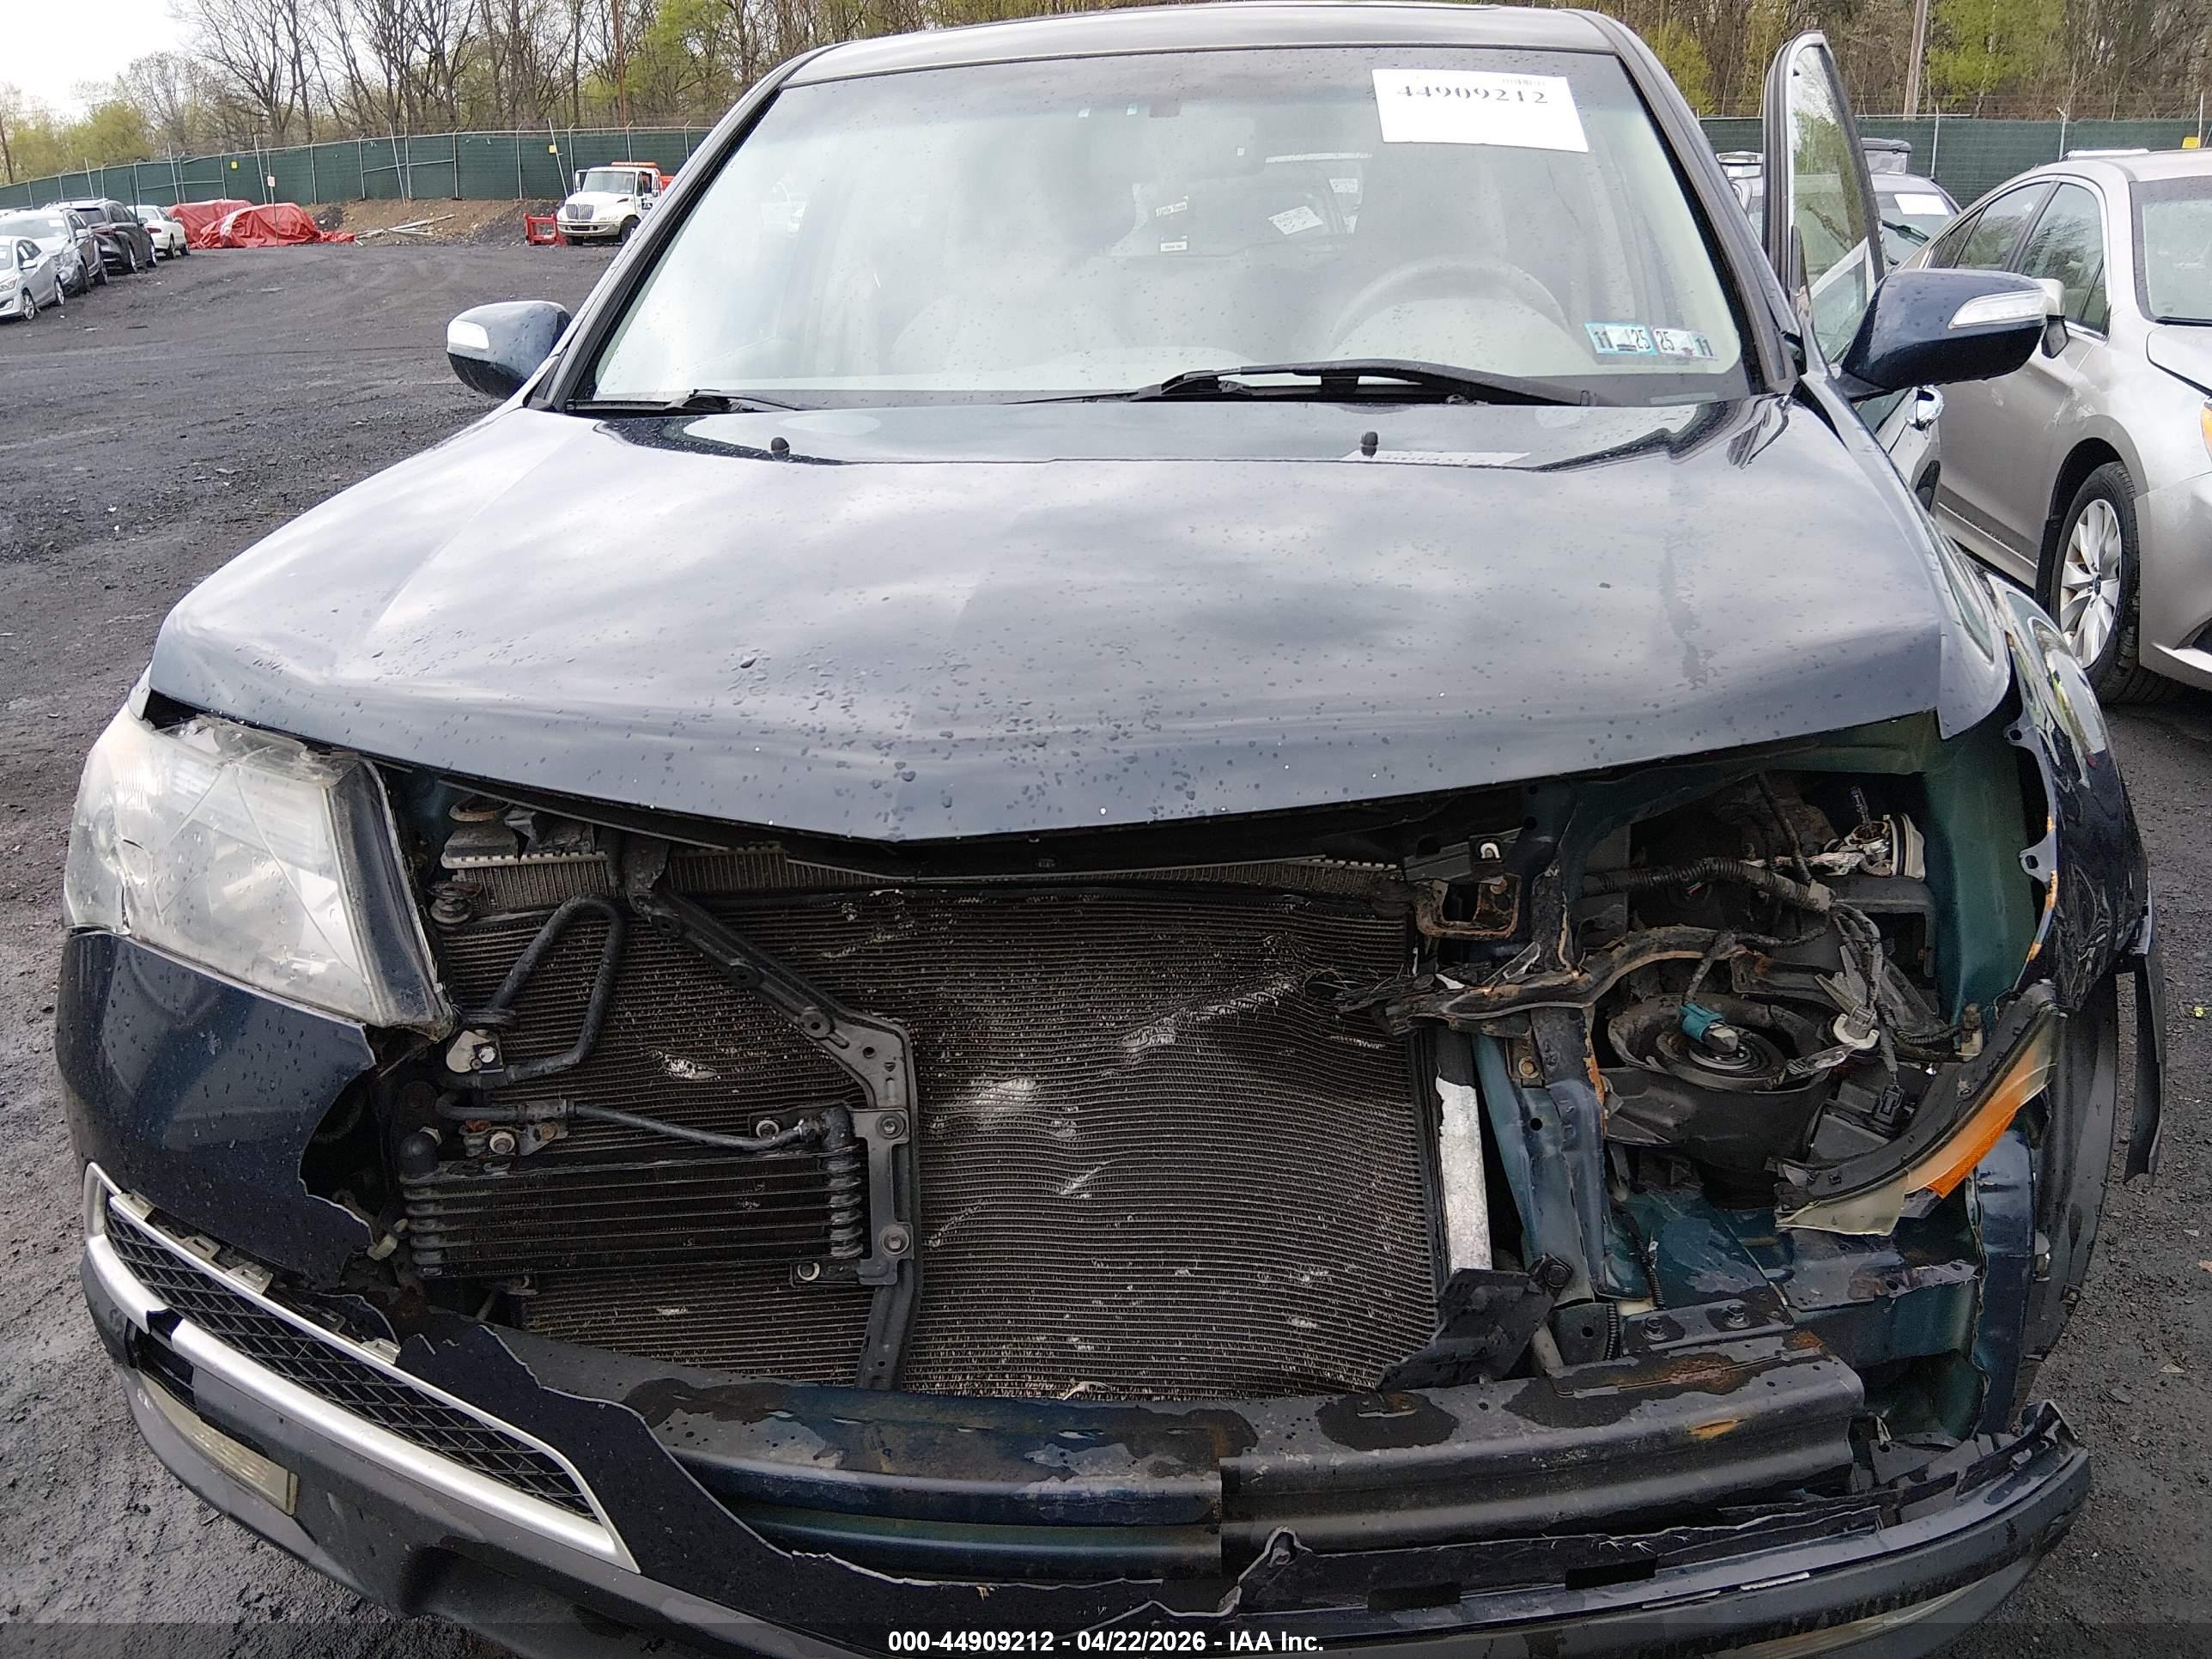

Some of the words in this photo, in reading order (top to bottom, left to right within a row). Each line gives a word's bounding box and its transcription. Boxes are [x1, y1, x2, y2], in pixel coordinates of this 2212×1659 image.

[1397, 85, 1548, 104] 44909212
[1594, 331, 1613, 349] 11
[1632, 329, 1651, 350] 25
[1656, 331, 1675, 351] 25
[1695, 337, 1714, 357] 11
